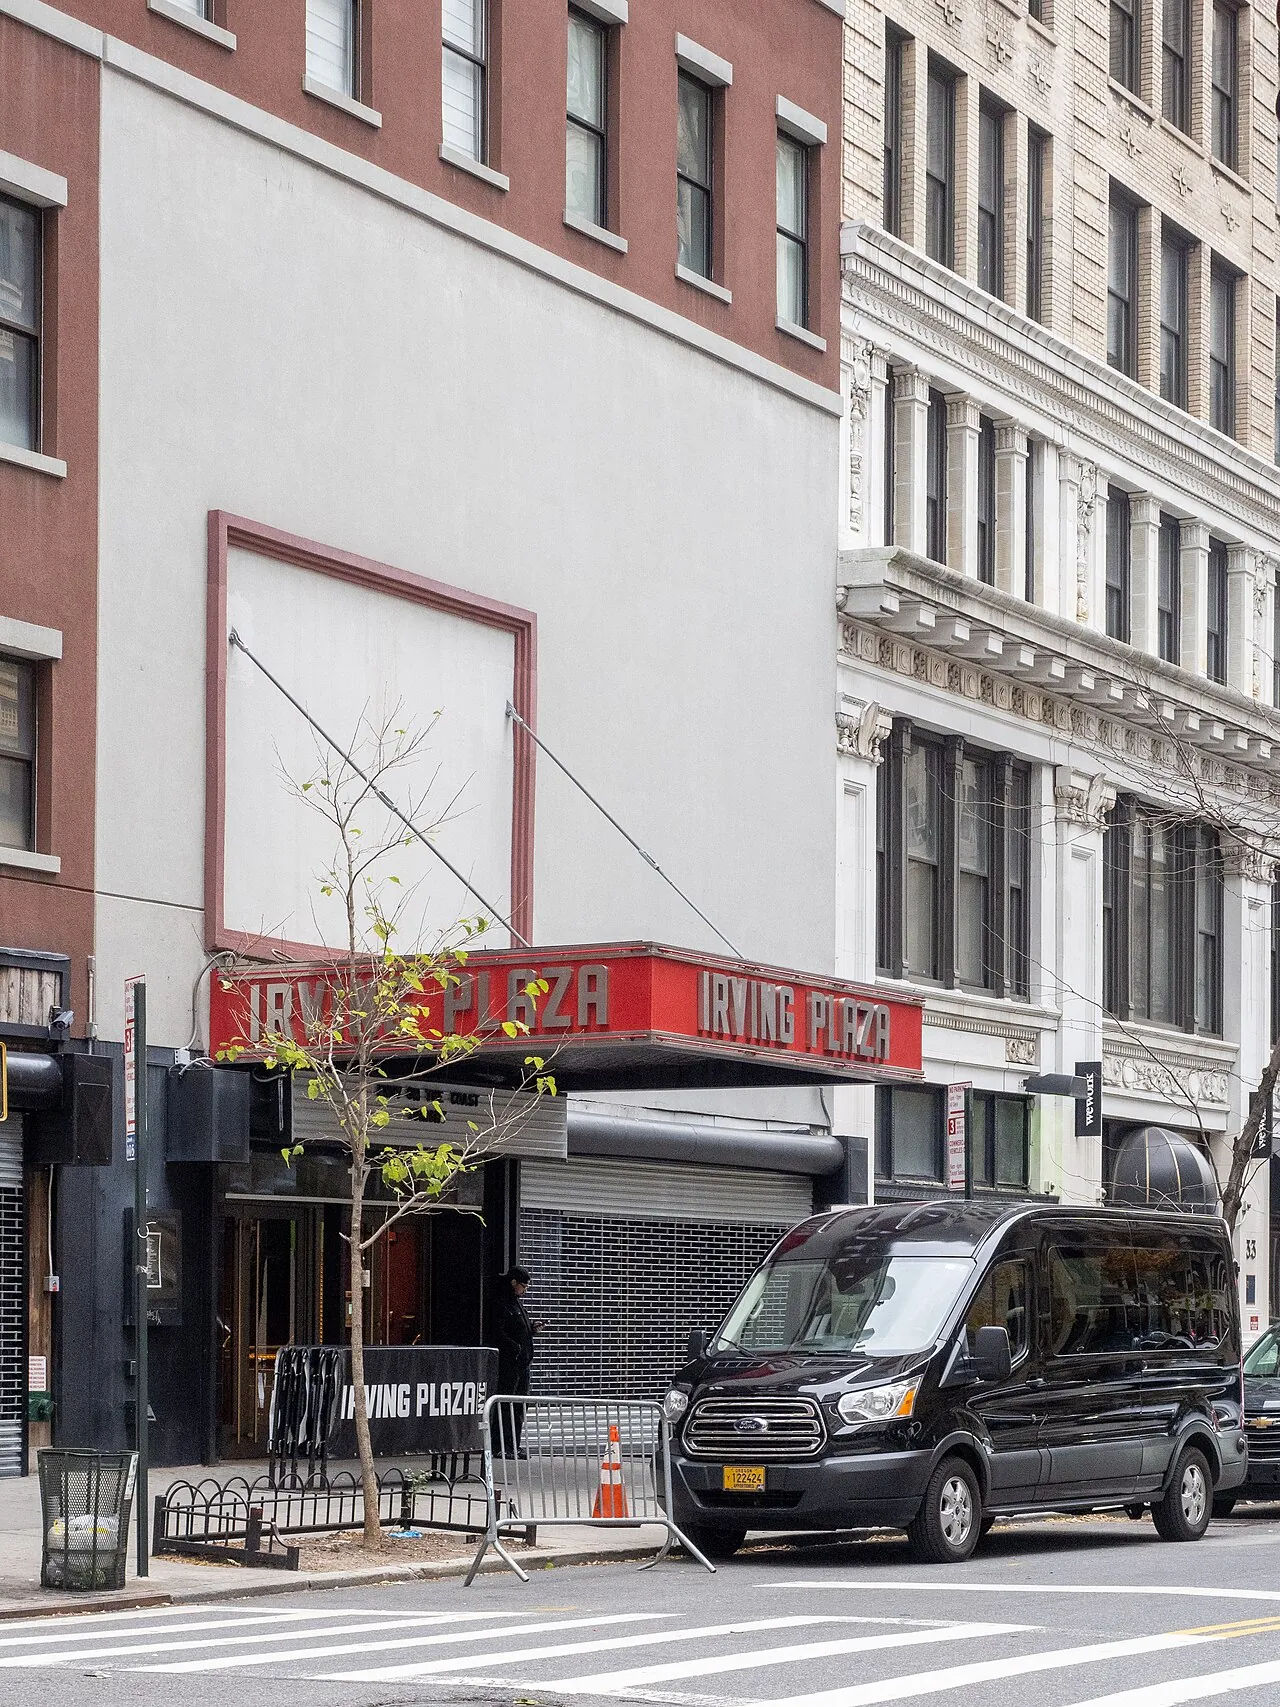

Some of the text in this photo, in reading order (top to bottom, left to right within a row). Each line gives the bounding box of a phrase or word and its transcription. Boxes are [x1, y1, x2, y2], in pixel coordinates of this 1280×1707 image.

[443, 964, 609, 1032] PLAZA
[698, 971, 890, 1060] IRVING PLAZA
[1085, 1072, 1094, 1126] wework
[1246, 1239, 1256, 1259] 33
[416, 1381, 476, 1417] PLAZA
[477, 1381, 487, 1415] NYC
[739, 1420, 757, 1429] Ford
[732, 1473, 762, 1484] 122424
